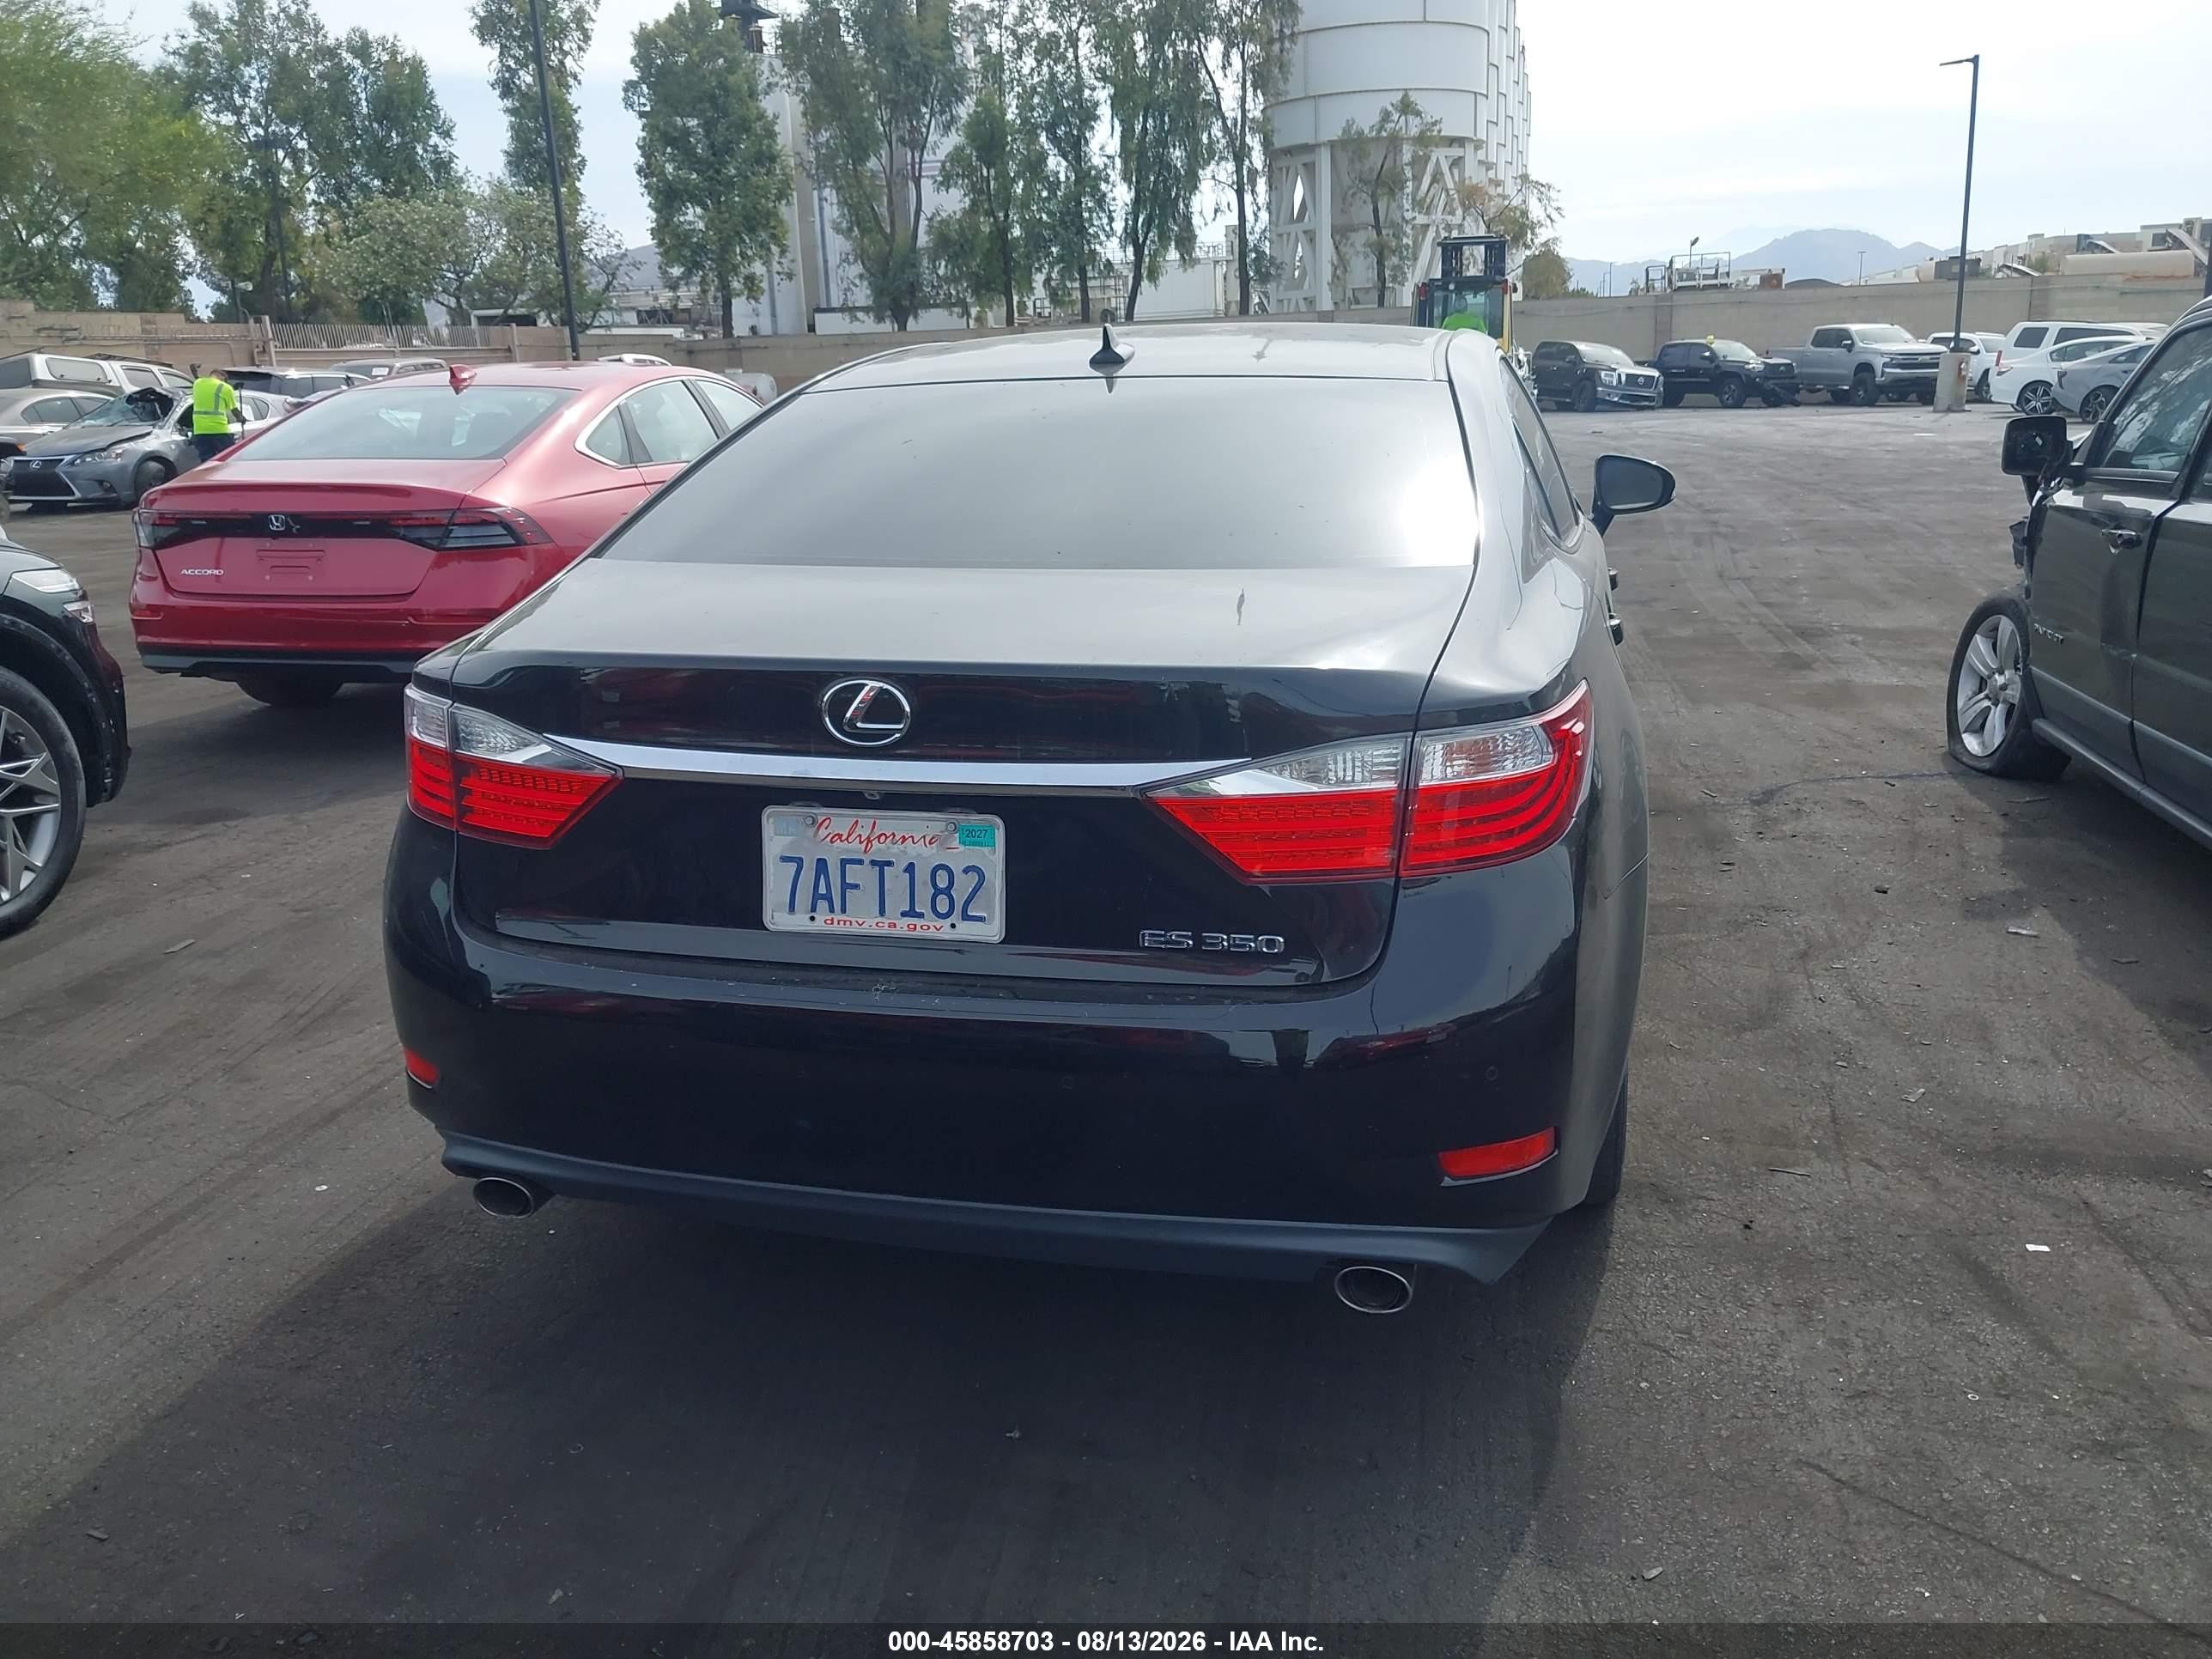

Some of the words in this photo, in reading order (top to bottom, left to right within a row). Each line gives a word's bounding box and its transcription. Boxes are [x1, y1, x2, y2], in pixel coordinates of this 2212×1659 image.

[815, 817, 959, 854] California
[965, 829, 988, 839] 2027
[779, 855, 987, 922] 7AFT182
[823, 916, 945, 933] dmv.ca.gov
[1139, 930, 1194, 949] ES
[1201, 933, 1285, 953] 350
